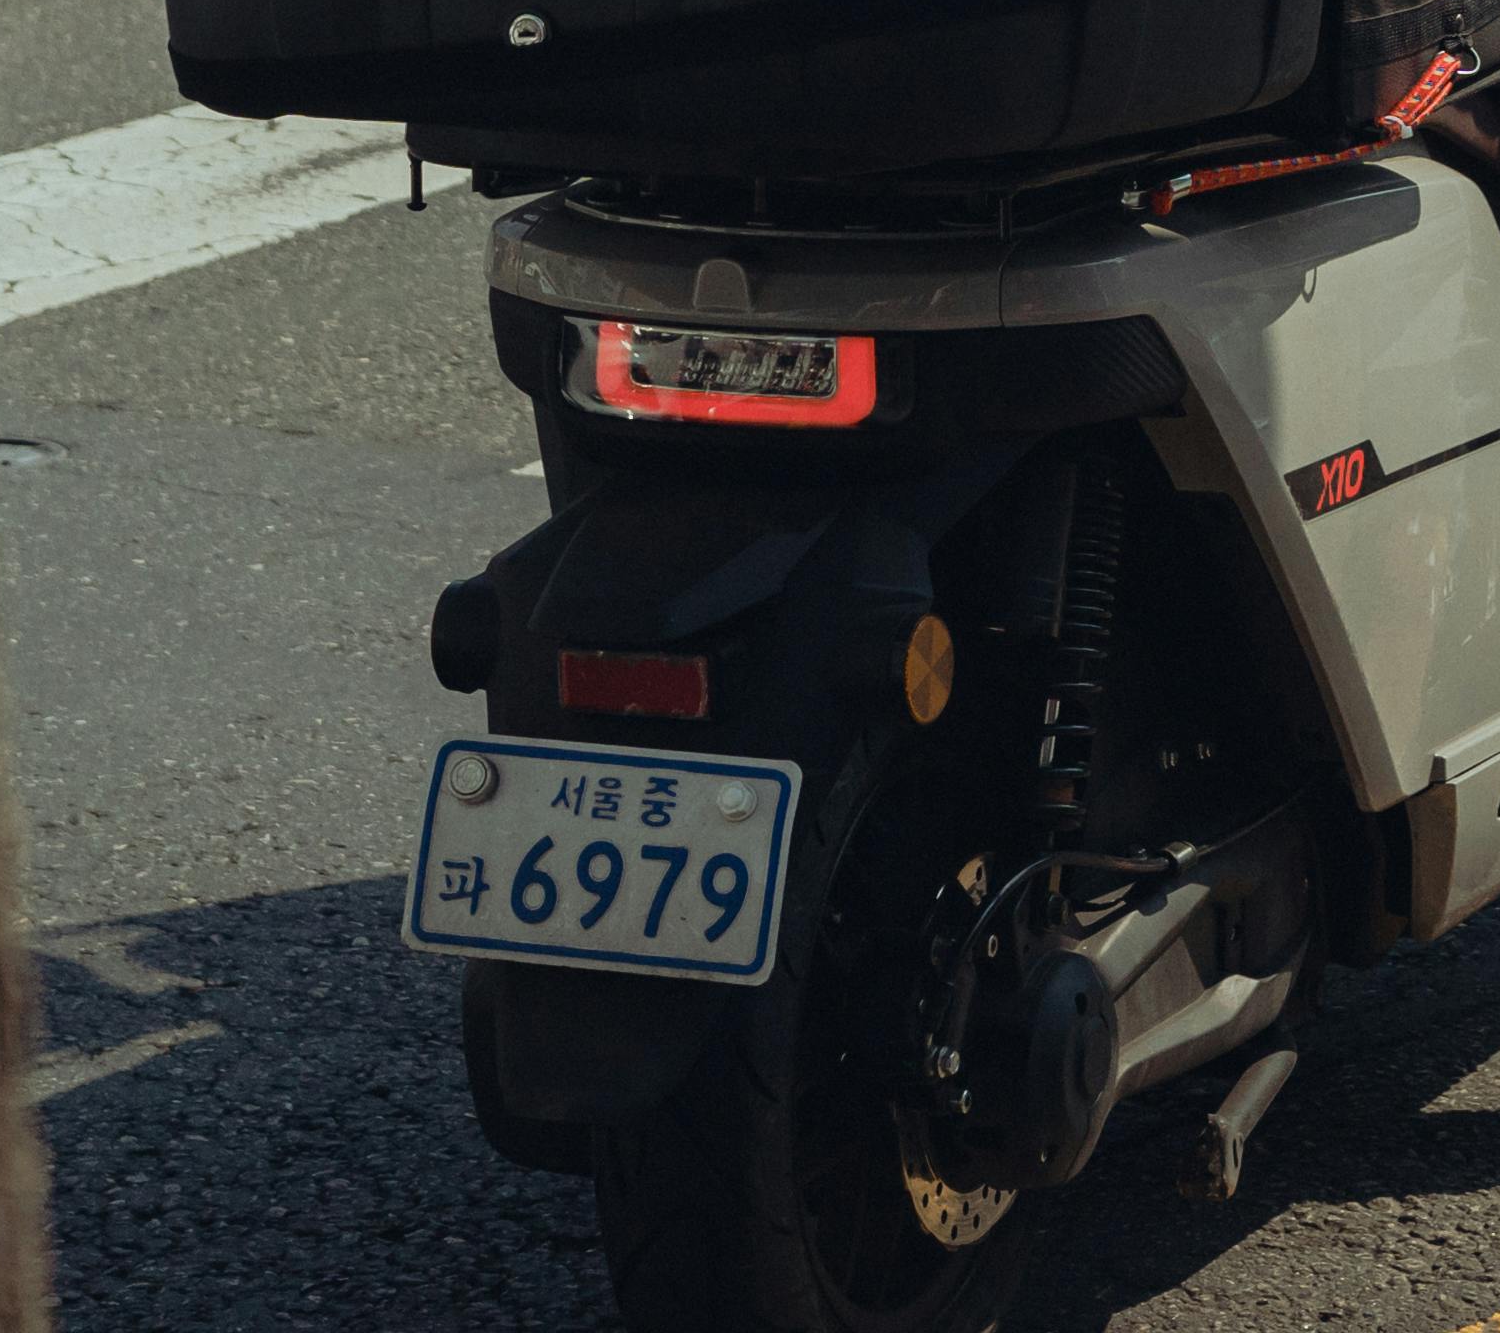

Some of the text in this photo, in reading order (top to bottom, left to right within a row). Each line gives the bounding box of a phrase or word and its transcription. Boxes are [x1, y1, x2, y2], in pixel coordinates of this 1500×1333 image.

[1316, 448, 1366, 512] X10
[550, 775, 680, 828] 서울 중
[439, 835, 750, 944] 파 6979
